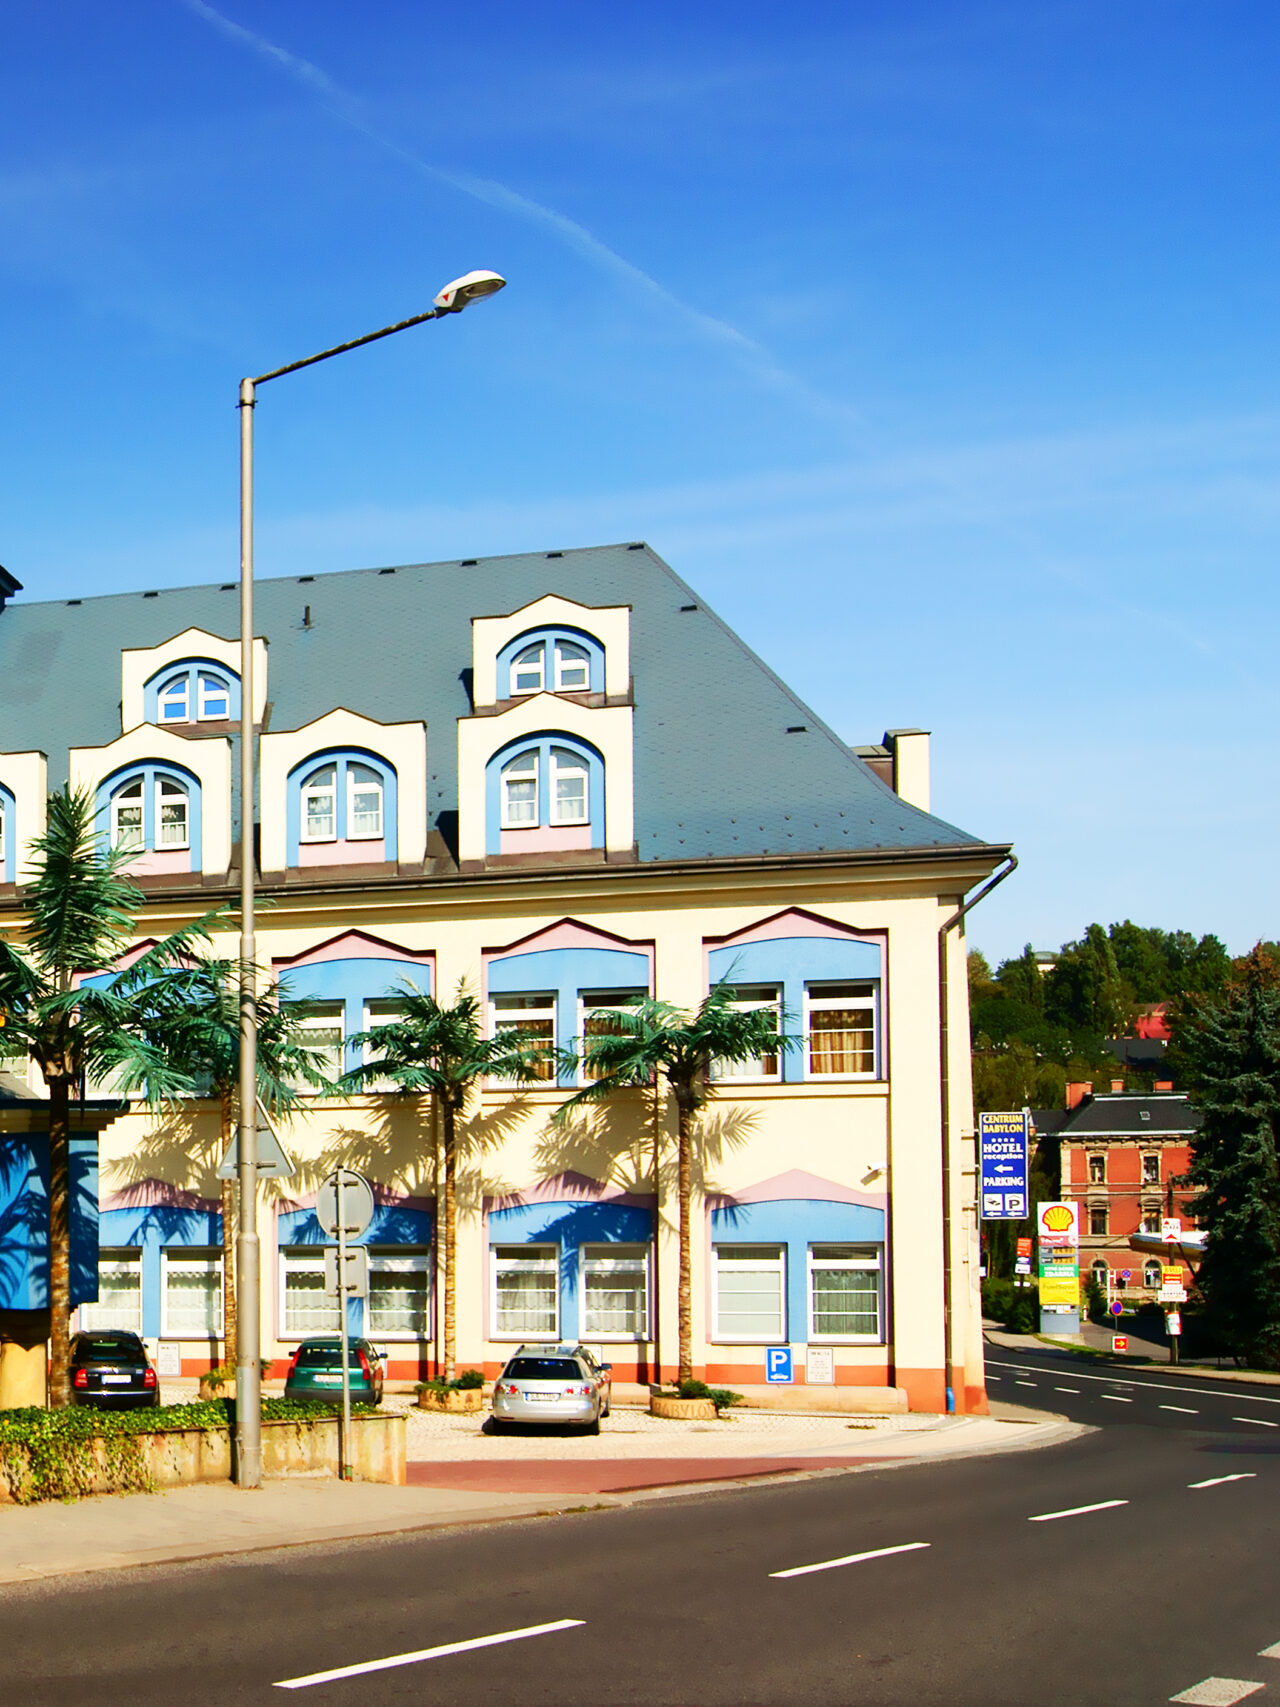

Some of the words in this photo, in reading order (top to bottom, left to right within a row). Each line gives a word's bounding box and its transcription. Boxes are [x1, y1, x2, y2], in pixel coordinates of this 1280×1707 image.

[982, 1114, 1024, 1123] CENTRUM
[982, 1123, 1024, 1133] BABYLON
[982, 1143, 1024, 1153] HOTEL
[983, 1152, 1024, 1160] reception
[983, 1176, 1025, 1187] PARKING
[771, 1351, 788, 1372] P
